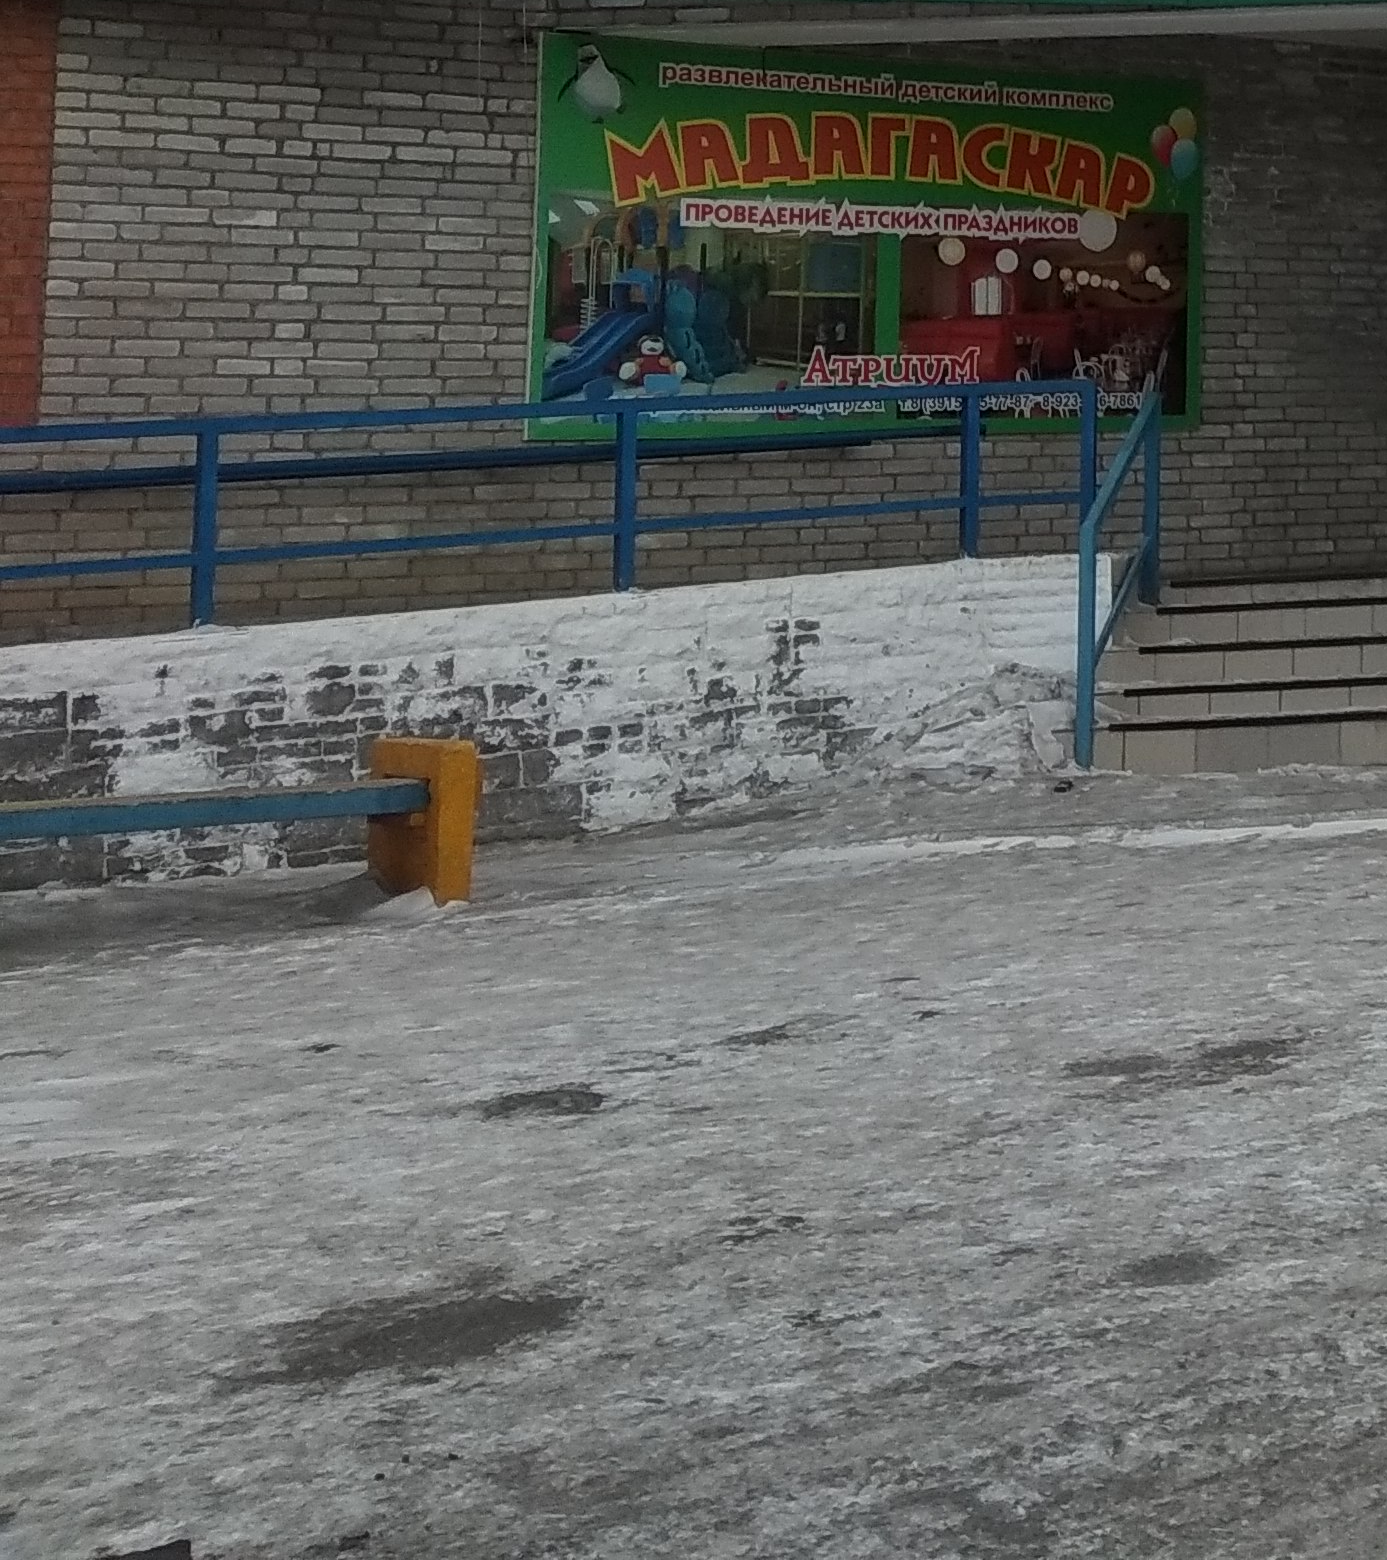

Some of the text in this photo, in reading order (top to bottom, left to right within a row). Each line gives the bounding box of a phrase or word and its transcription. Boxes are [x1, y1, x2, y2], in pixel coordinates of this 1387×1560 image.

[659, 61, 1113, 112] развлекательный детский комплекс
[604, 112, 1156, 216] МАДАГАСКАР
[684, 203, 1080, 236] ПРОВЕДЕНИЕ ДЕТСКИХ ПРАЗДНИКОВ
